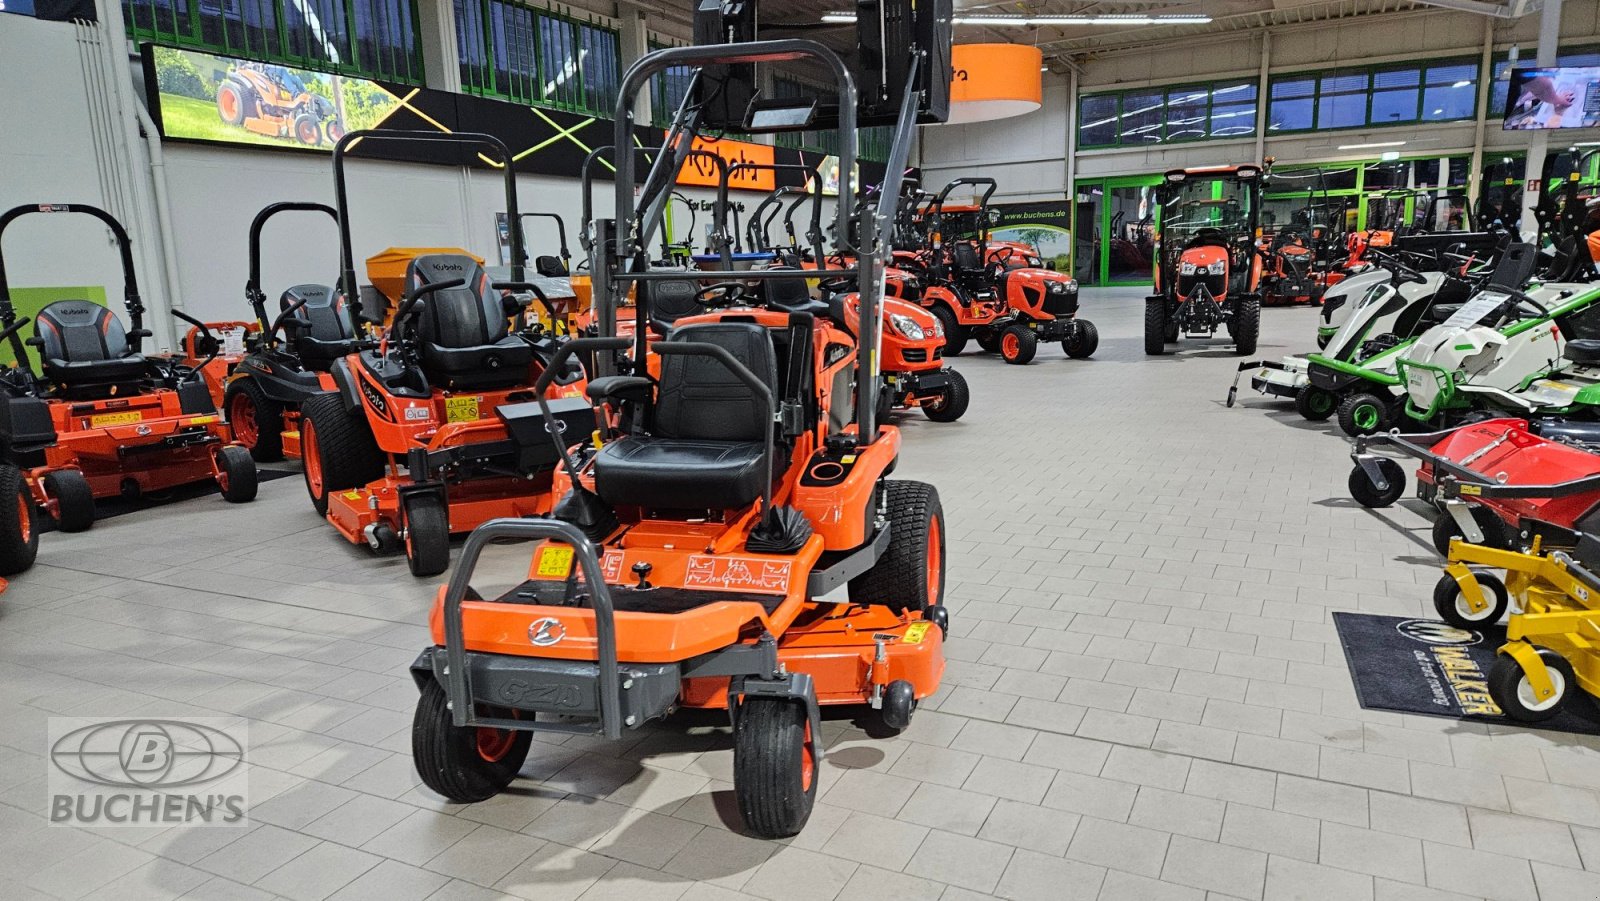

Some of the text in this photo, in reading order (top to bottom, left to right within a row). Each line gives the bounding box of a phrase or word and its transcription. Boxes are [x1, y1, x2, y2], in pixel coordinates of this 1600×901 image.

[1004, 210, 1066, 220] www.buchens.de
[432, 263, 463, 271] Kubota
[1430, 646, 1504, 716] WALKER
